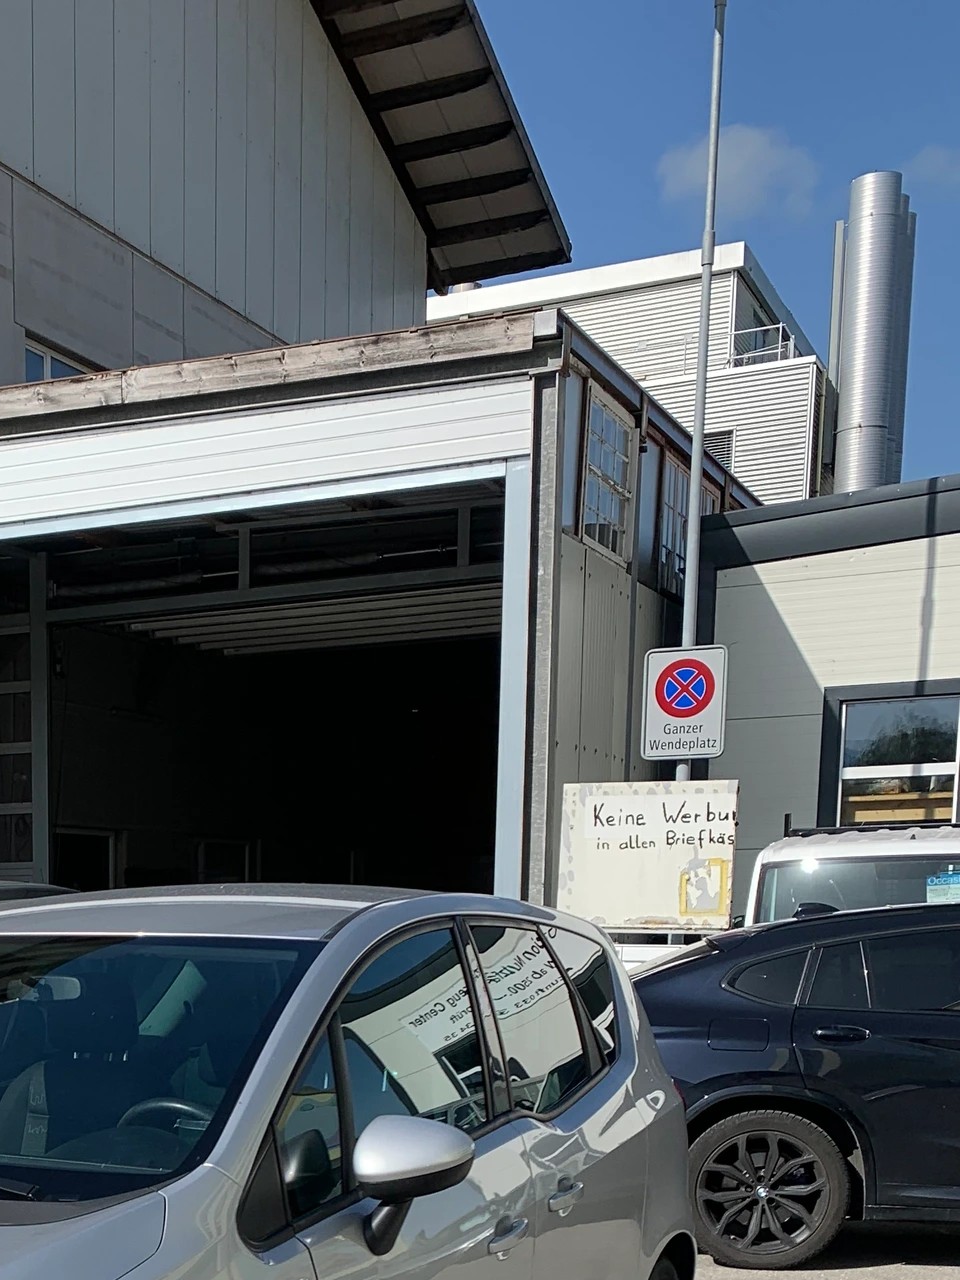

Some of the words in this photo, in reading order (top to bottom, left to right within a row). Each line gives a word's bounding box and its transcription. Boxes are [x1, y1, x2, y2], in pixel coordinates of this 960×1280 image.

[663, 723, 704, 735] Ganzer
[649, 737, 717, 752] Wendeplatz
[593, 802, 646, 827] Keine
[596, 837, 610, 850] in
[619, 834, 656, 850] allen
[666, 828, 735, 849] Briefkäs
[928, 876, 960, 885] Occas
